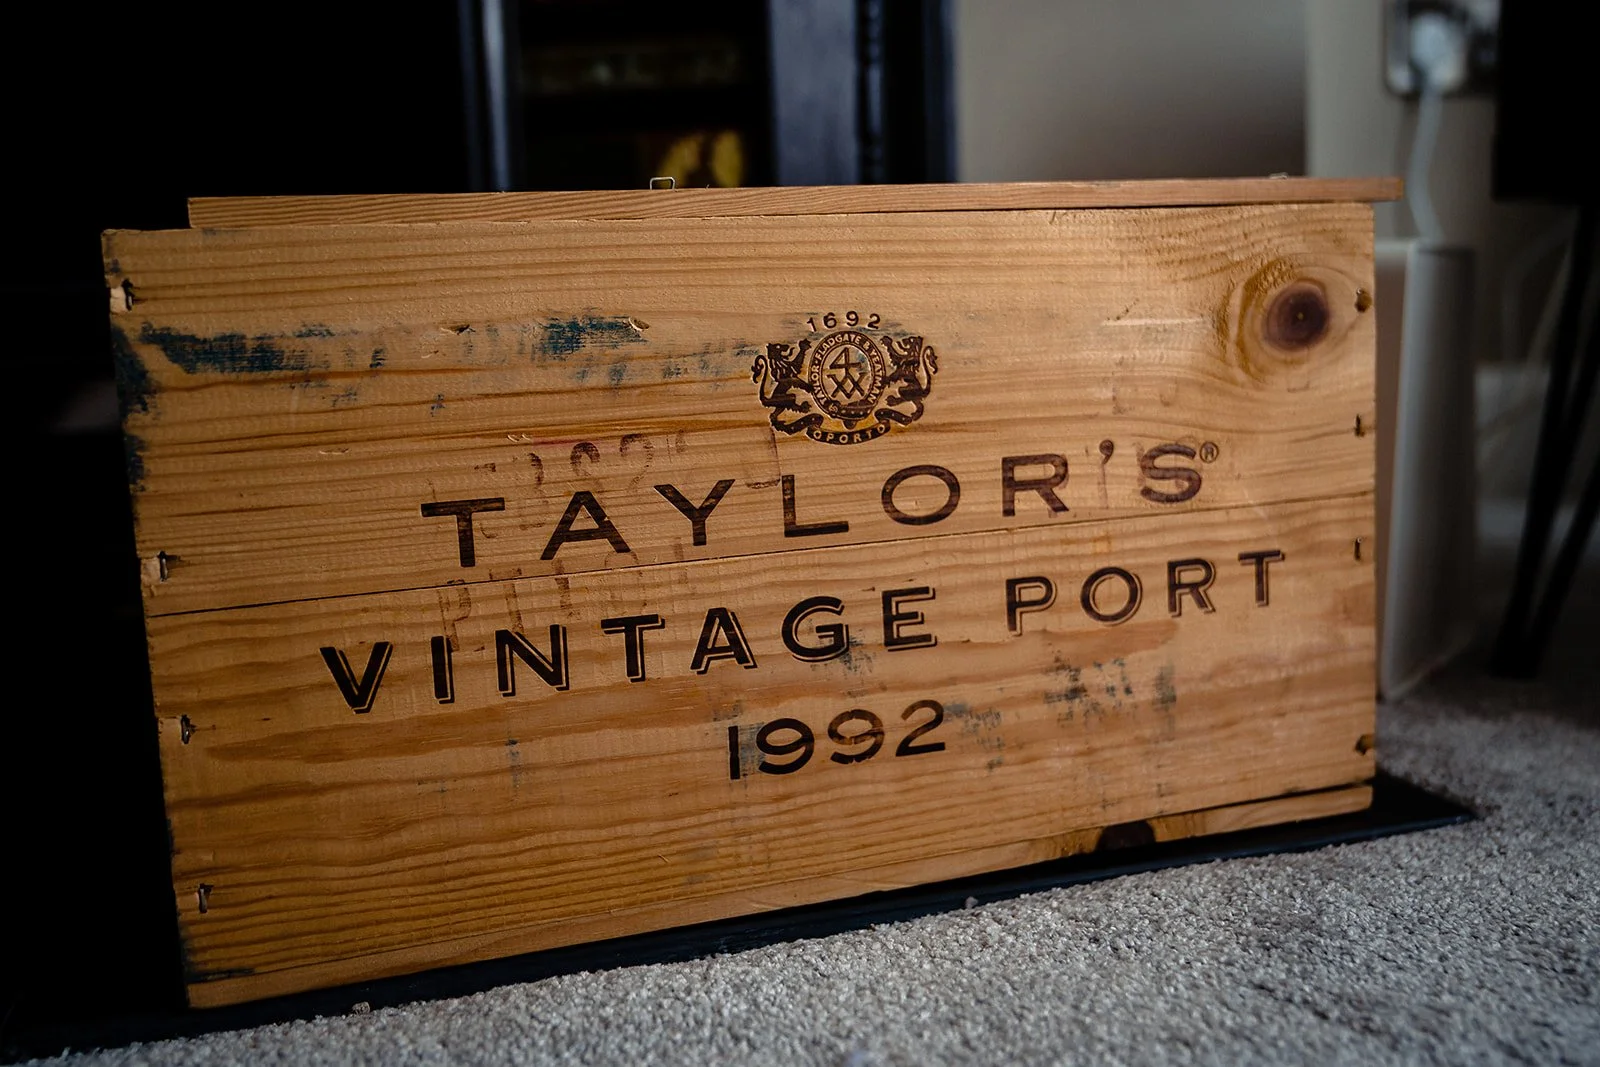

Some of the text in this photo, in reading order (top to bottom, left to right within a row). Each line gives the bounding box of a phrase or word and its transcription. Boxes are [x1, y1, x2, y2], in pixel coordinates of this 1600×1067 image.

[806, 310, 881, 332] 1692
[816, 333, 863, 361] FLADGATE
[810, 363, 828, 407] TAYLOR
[869, 349, 884, 404] YEATMAN
[812, 423, 887, 444] OPORTO
[319, 585, 937, 714] VINTAGE
[1005, 550, 1284, 636] PORT
[728, 699, 946, 780] 1992
